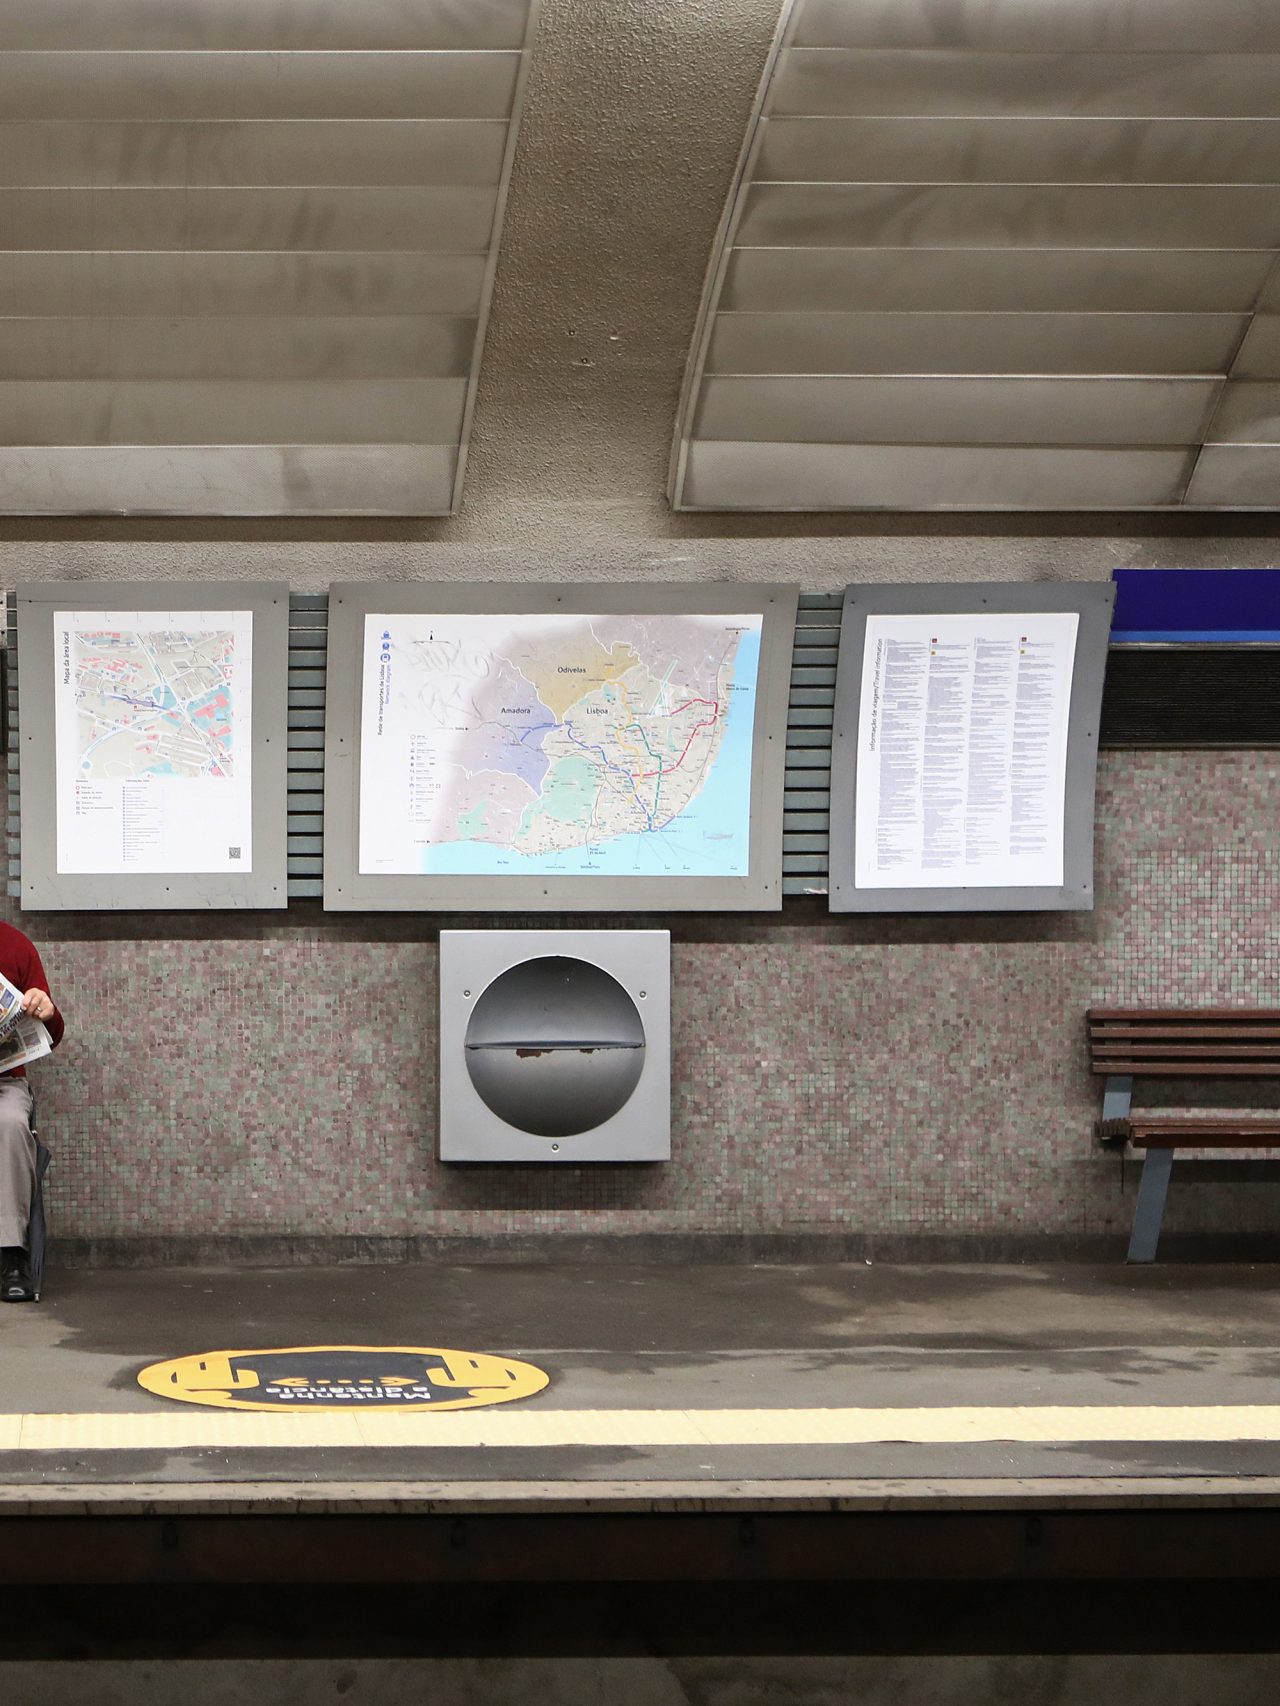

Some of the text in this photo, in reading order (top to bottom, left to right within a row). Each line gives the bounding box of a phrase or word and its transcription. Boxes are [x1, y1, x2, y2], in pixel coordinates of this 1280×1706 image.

[62, 631, 70, 645] local
[557, 666, 587, 674] Odivelas
[63, 668, 71, 685] Mapa
[500, 707, 531, 715] Amadora
[586, 707, 608, 715] Lisboa
